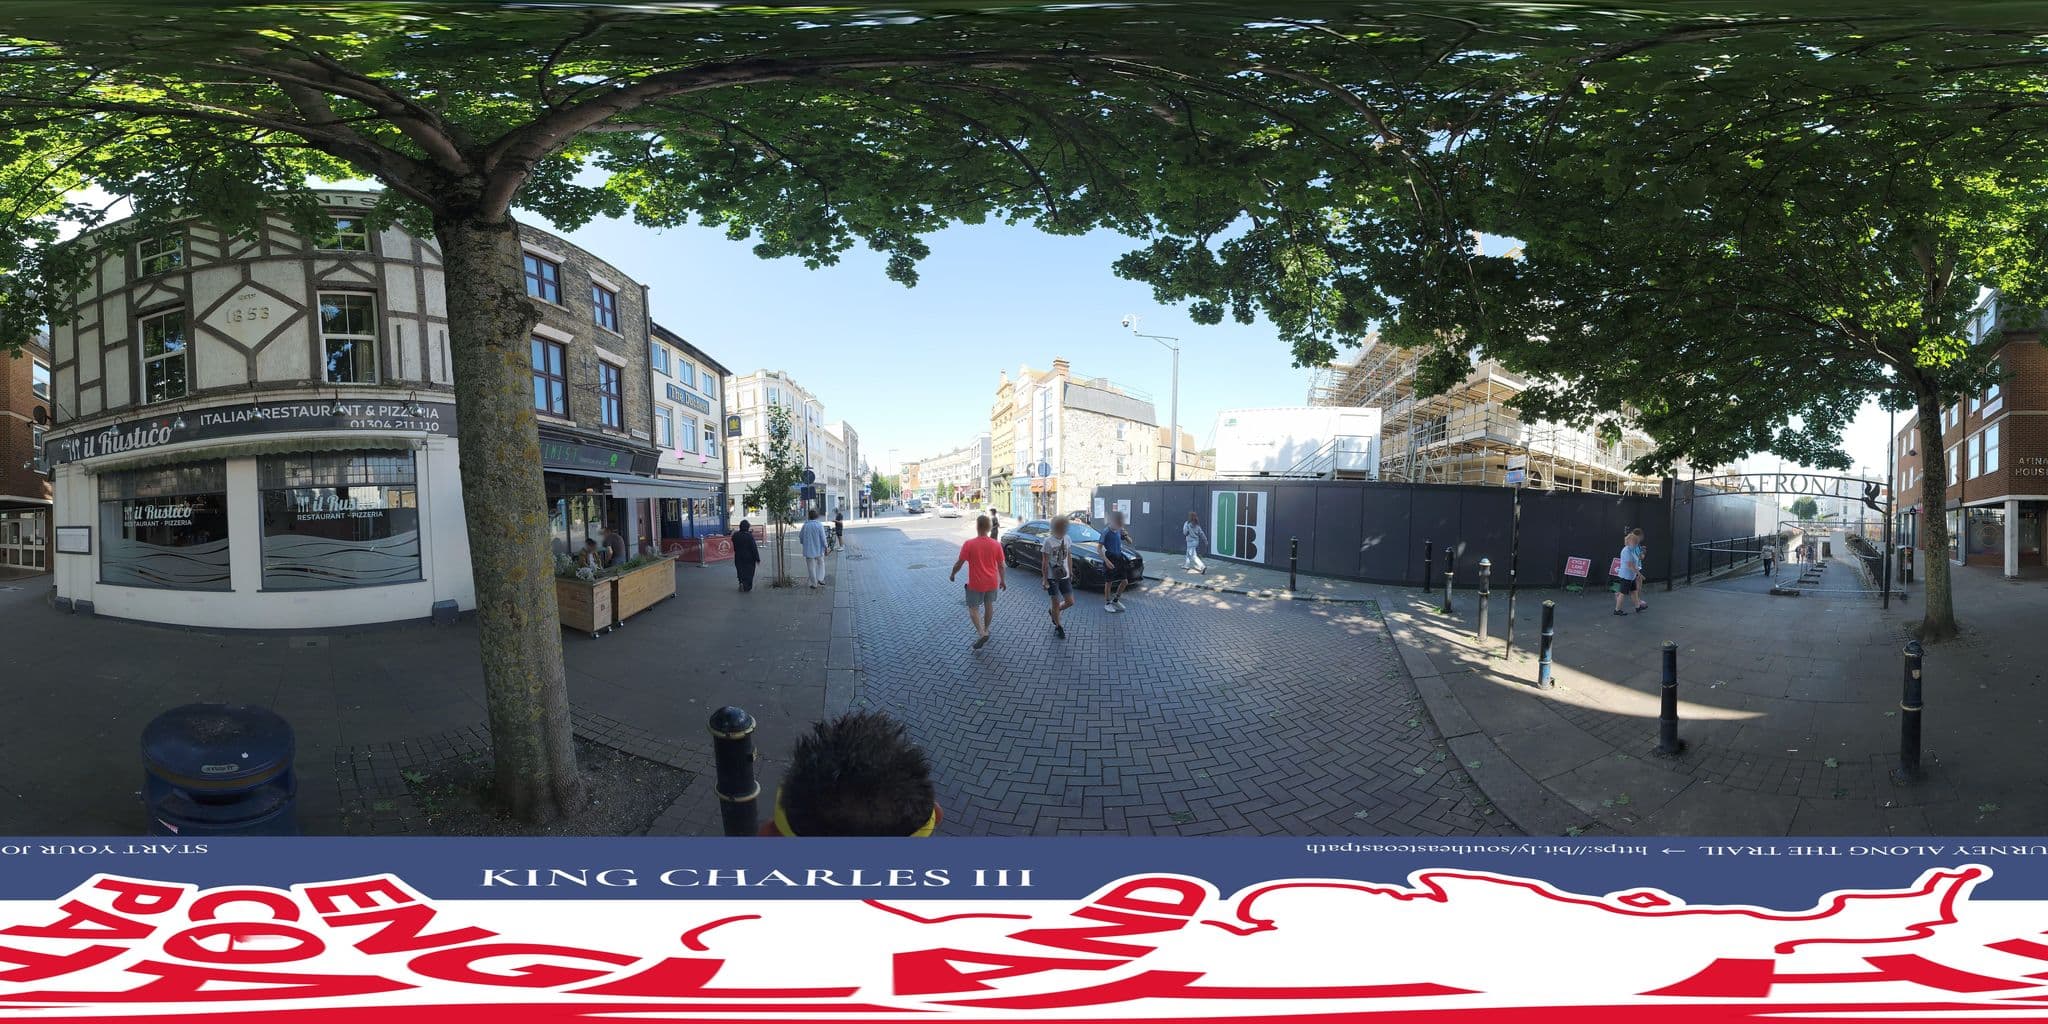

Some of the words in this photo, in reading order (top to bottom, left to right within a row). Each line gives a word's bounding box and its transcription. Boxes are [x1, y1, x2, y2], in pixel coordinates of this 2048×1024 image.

[262, 405, 361, 419] RESTAURNT
[366, 405, 375, 416] &
[98, 420, 173, 455] Rustico
[144, 503, 193, 520] Rustico
[297, 512, 346, 521] RESTAURANT
